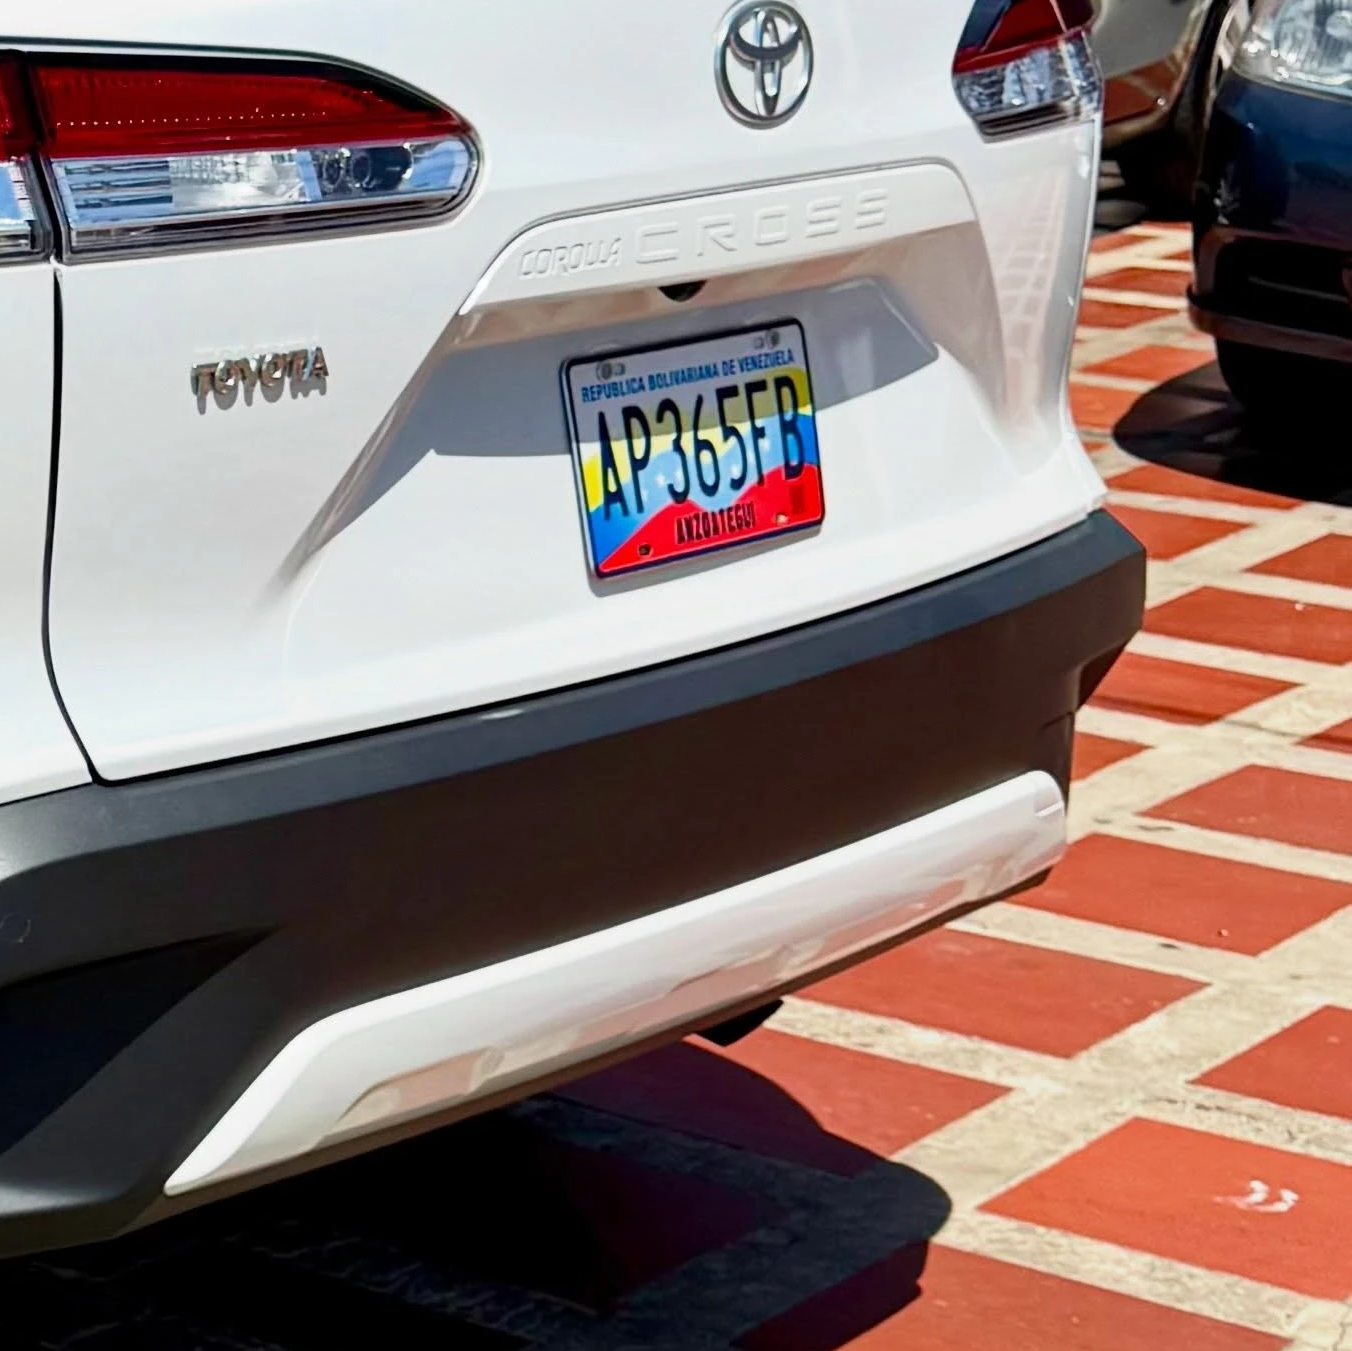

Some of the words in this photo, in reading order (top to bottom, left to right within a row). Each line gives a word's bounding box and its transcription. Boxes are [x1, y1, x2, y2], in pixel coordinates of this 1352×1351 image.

[518, 235, 623, 278] COROLLA
[635, 188, 889, 265] CROSS
[190, 346, 330, 398] TOYOTA
[581, 377, 646, 404] REPUBLICA
[647, 366, 720, 392] BOLIVARIANA
[721, 359, 737, 377] DE
[737, 347, 795, 373] VENEZUELA
[597, 375, 805, 521] AP365FB
